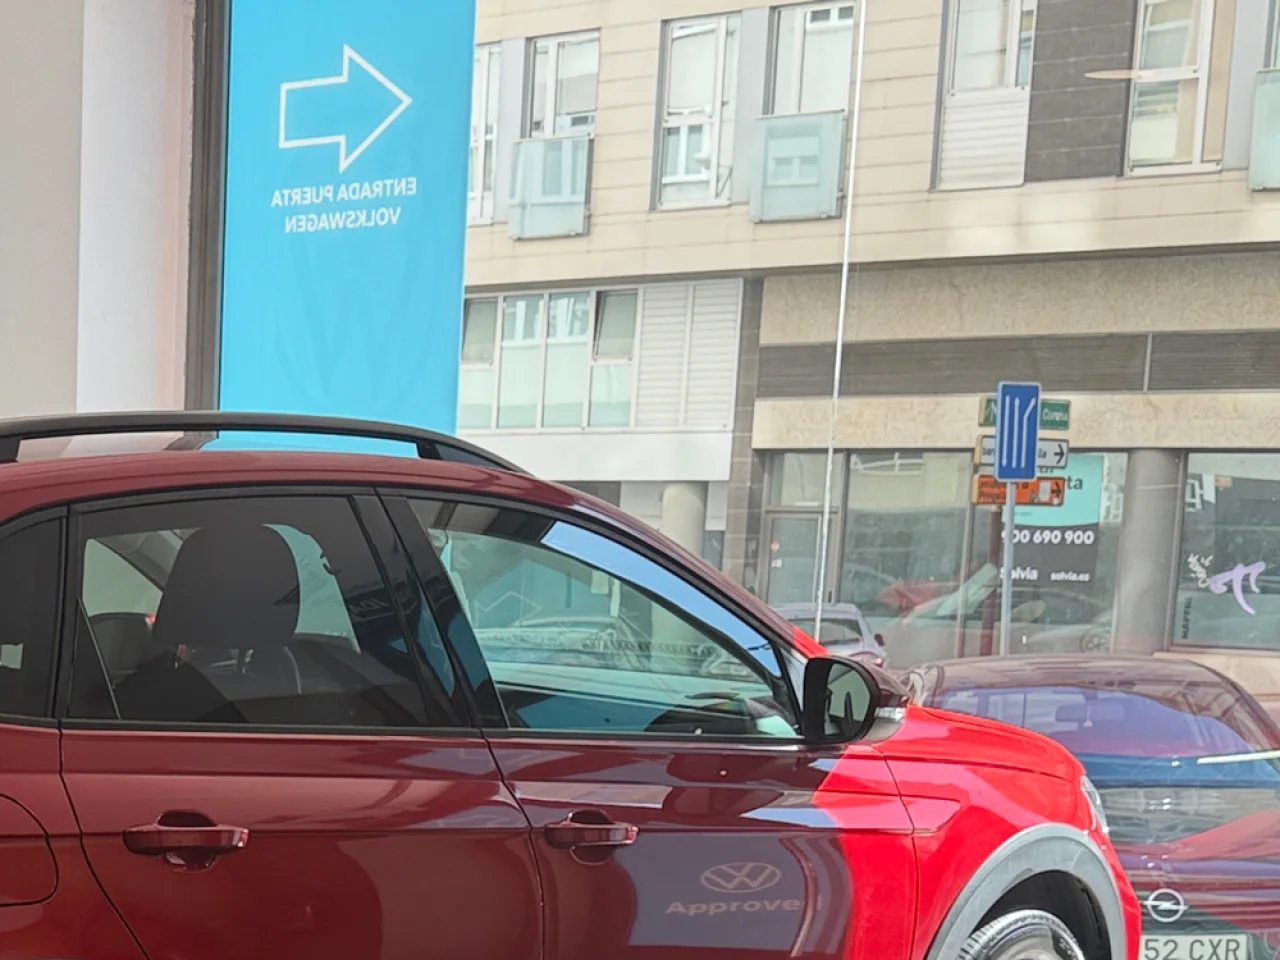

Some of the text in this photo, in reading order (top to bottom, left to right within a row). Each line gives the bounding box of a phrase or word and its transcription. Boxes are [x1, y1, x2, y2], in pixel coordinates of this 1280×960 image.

[1000, 530, 1095, 545] 00 690 900
